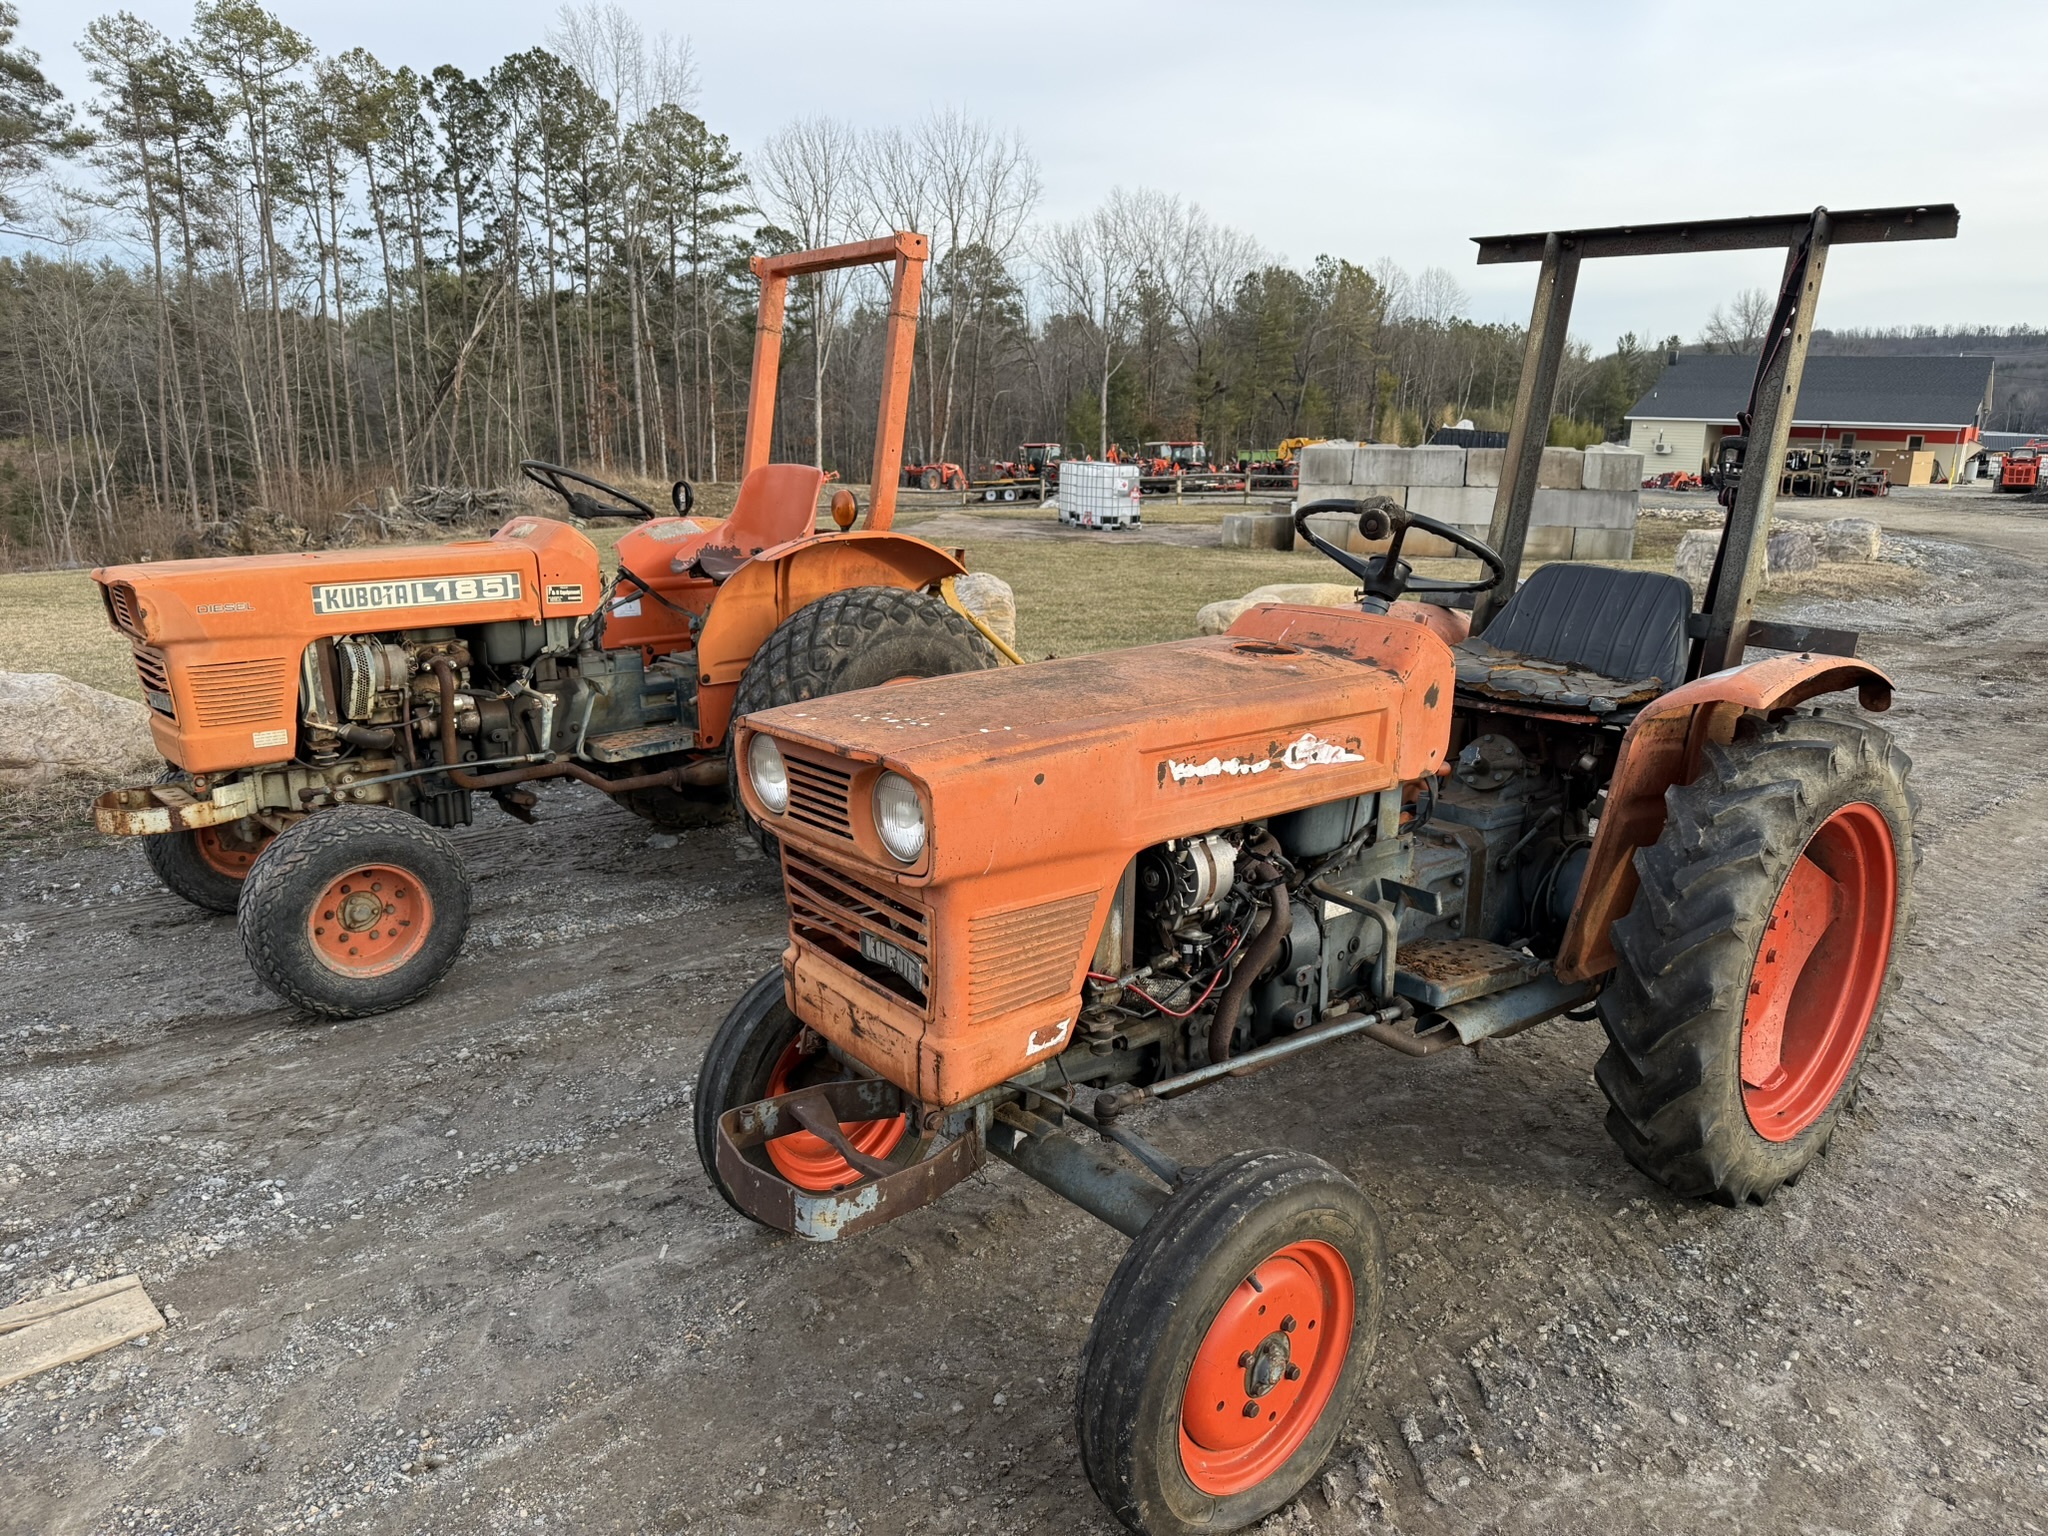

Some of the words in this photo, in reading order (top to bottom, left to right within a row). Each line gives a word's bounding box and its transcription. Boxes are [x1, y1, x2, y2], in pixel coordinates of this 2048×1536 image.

[325, 584, 408, 609] KUBOTA
[416, 578, 505, 602] L185
[197, 603, 255, 614] DIESEL
